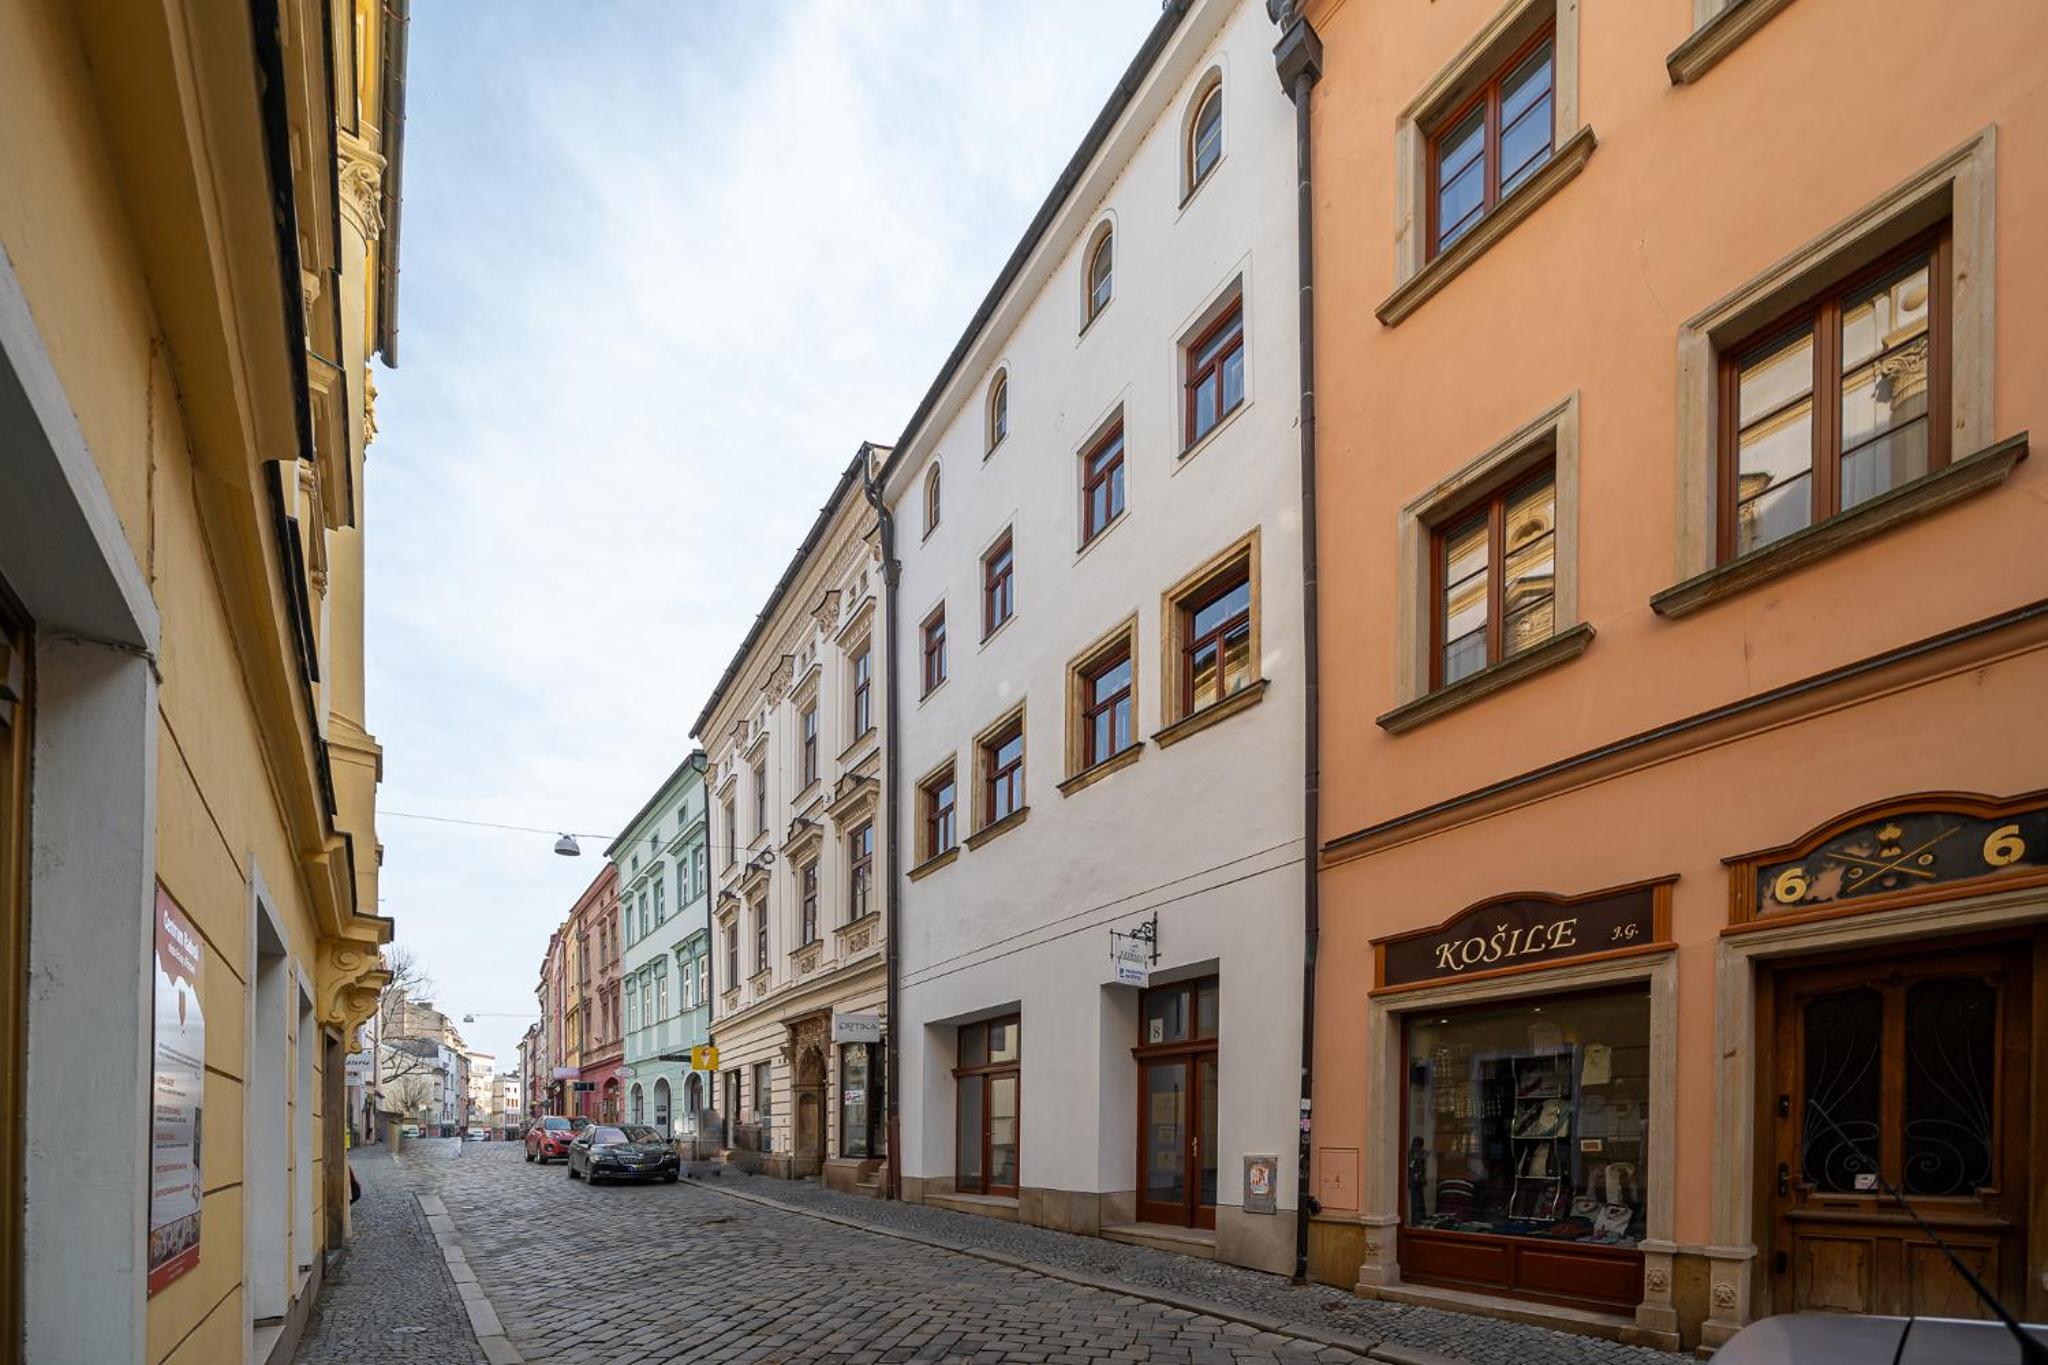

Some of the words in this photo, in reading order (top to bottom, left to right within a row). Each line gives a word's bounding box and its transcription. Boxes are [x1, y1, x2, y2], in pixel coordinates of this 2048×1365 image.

[1775, 867, 1807, 903] 6
[1983, 824, 2026, 867] 6
[1435, 918, 1578, 971] KOŠILE
[1153, 1025, 1160, 1040] 8
